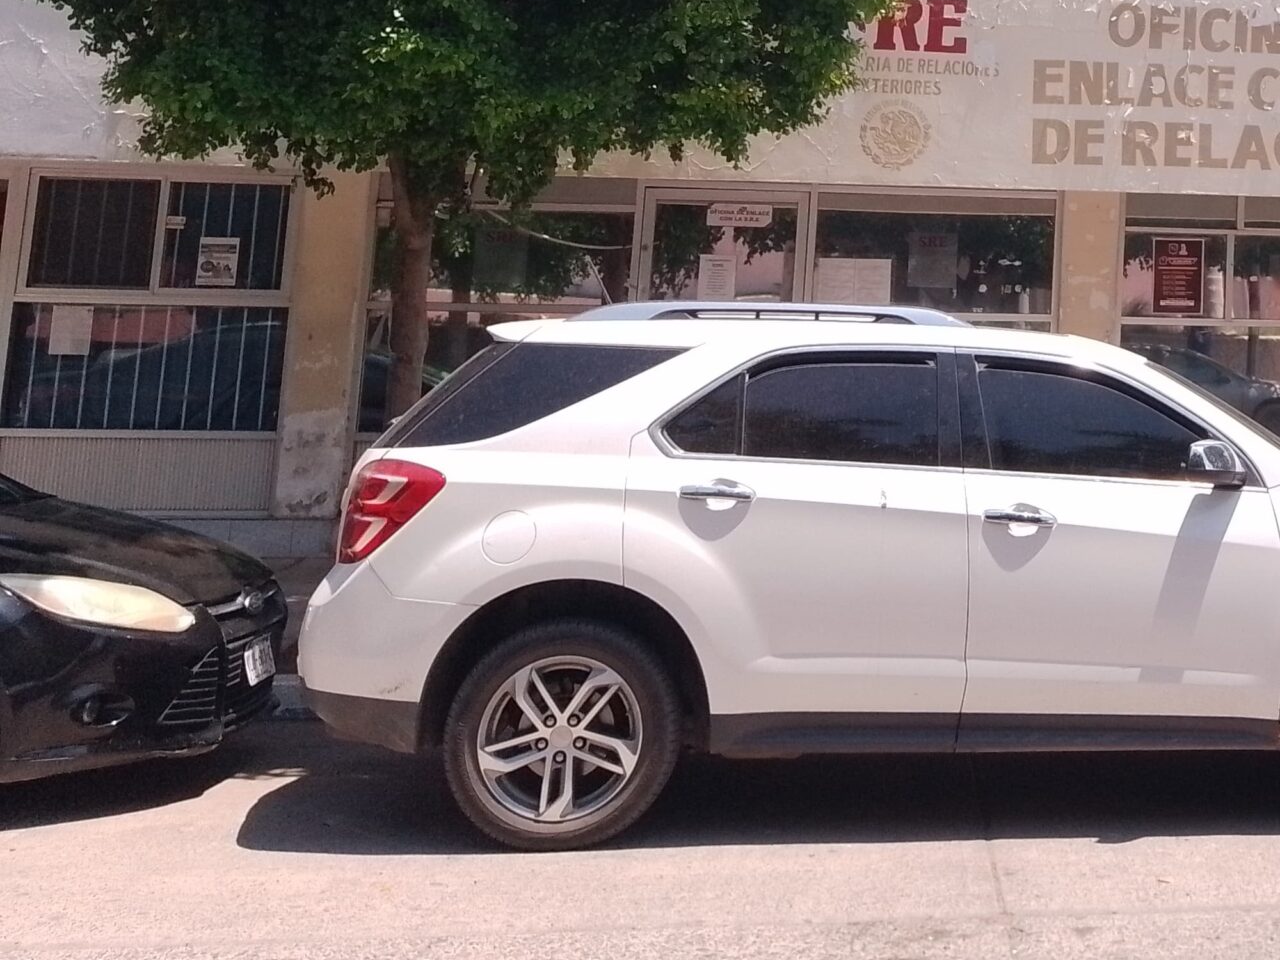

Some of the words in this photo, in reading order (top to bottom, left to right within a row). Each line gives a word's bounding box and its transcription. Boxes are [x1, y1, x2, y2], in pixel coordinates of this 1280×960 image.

[897, 58, 914, 73] DE
[1032, 59, 1236, 110] ENLACE
[1031, 118, 1105, 166] DE
[710, 207, 734, 215] OFICINA
